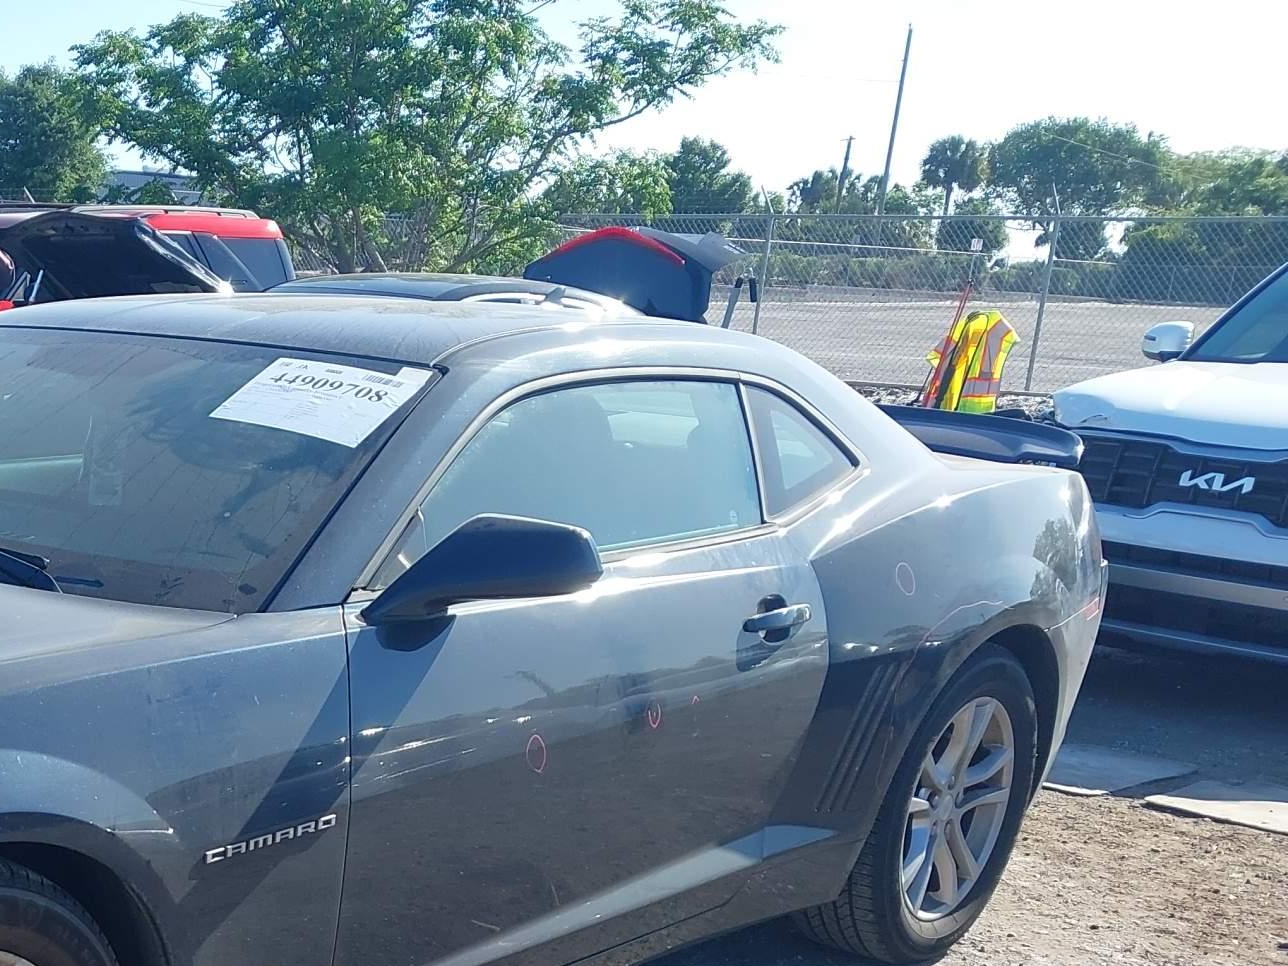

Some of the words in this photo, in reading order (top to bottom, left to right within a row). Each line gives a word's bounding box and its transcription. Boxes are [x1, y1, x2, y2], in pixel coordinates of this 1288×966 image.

[269, 372, 389, 402] 44909708
[1178, 469, 1256, 495] KIA
[204, 813, 337, 865] CAMARO
